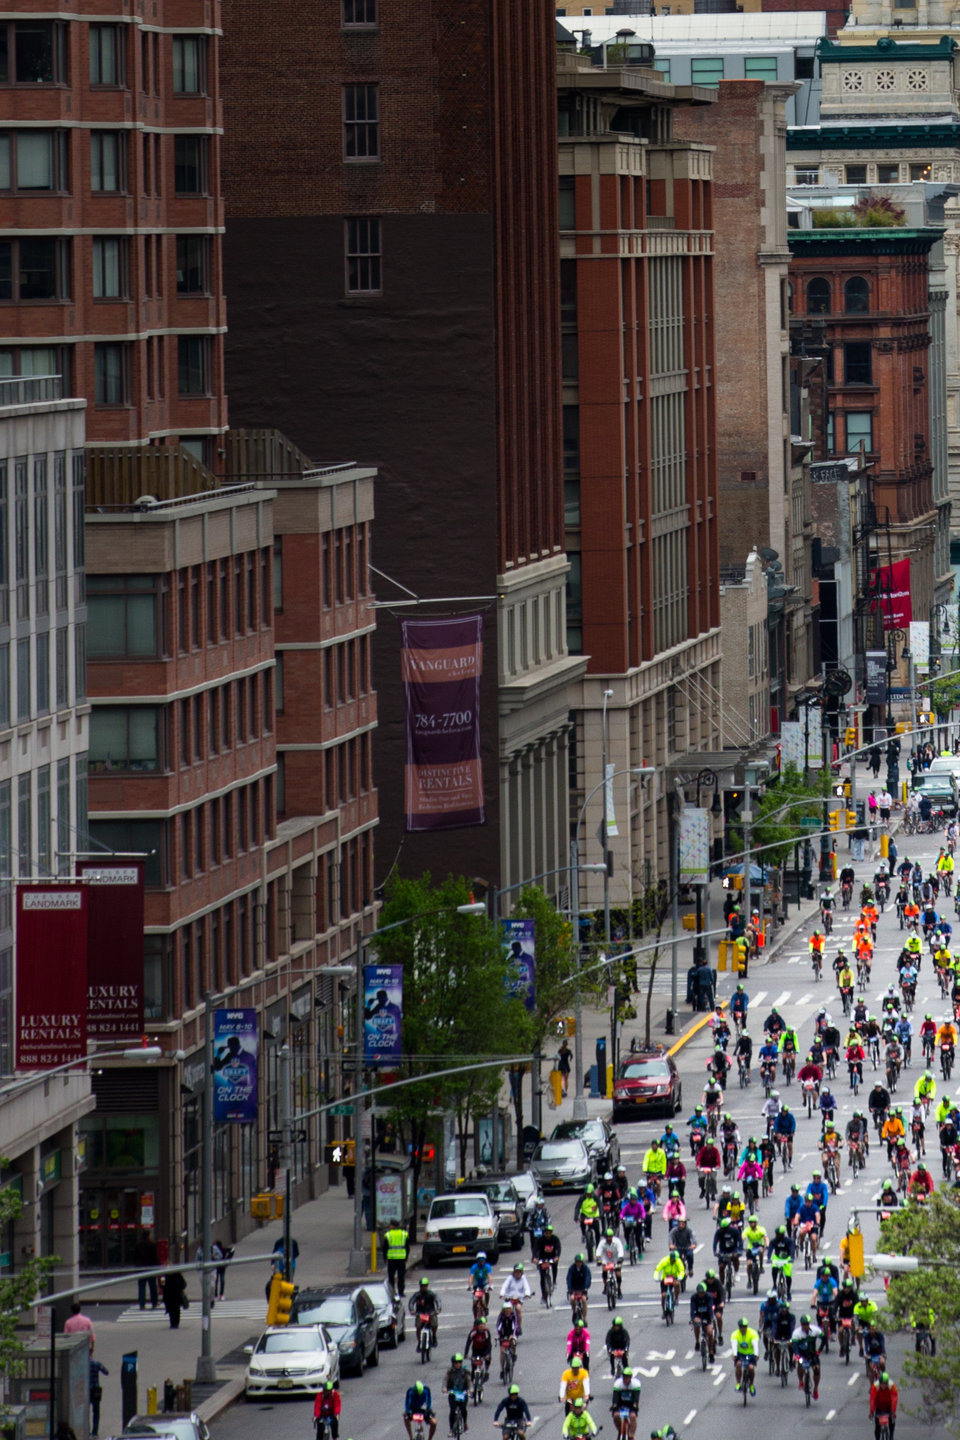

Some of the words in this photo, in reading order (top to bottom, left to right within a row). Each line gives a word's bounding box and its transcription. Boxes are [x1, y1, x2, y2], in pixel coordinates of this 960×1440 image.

[410, 656, 475, 671] VANGUARD
[415, 710, 472, 728] 784-7700
[418, 765, 472, 777] DISTINCTIVE
[418, 775, 473, 789] RENTALS
[25, 900, 79, 909] LANDMARK
[20, 1014, 81, 1028] LUXURY
[20, 1027, 81, 1040] RENTALS
[367, 1033, 381, 1041] ON
[382, 1032, 398, 1040] THE
[368, 1040, 395, 1048] CLOCK
[20, 1054, 38, 1064] 888
[40, 1054, 59, 1064] 824
[217, 1086, 232, 1094] ON
[234, 1086, 253, 1094] THE
[218, 1093, 249, 1102] CLOCK
